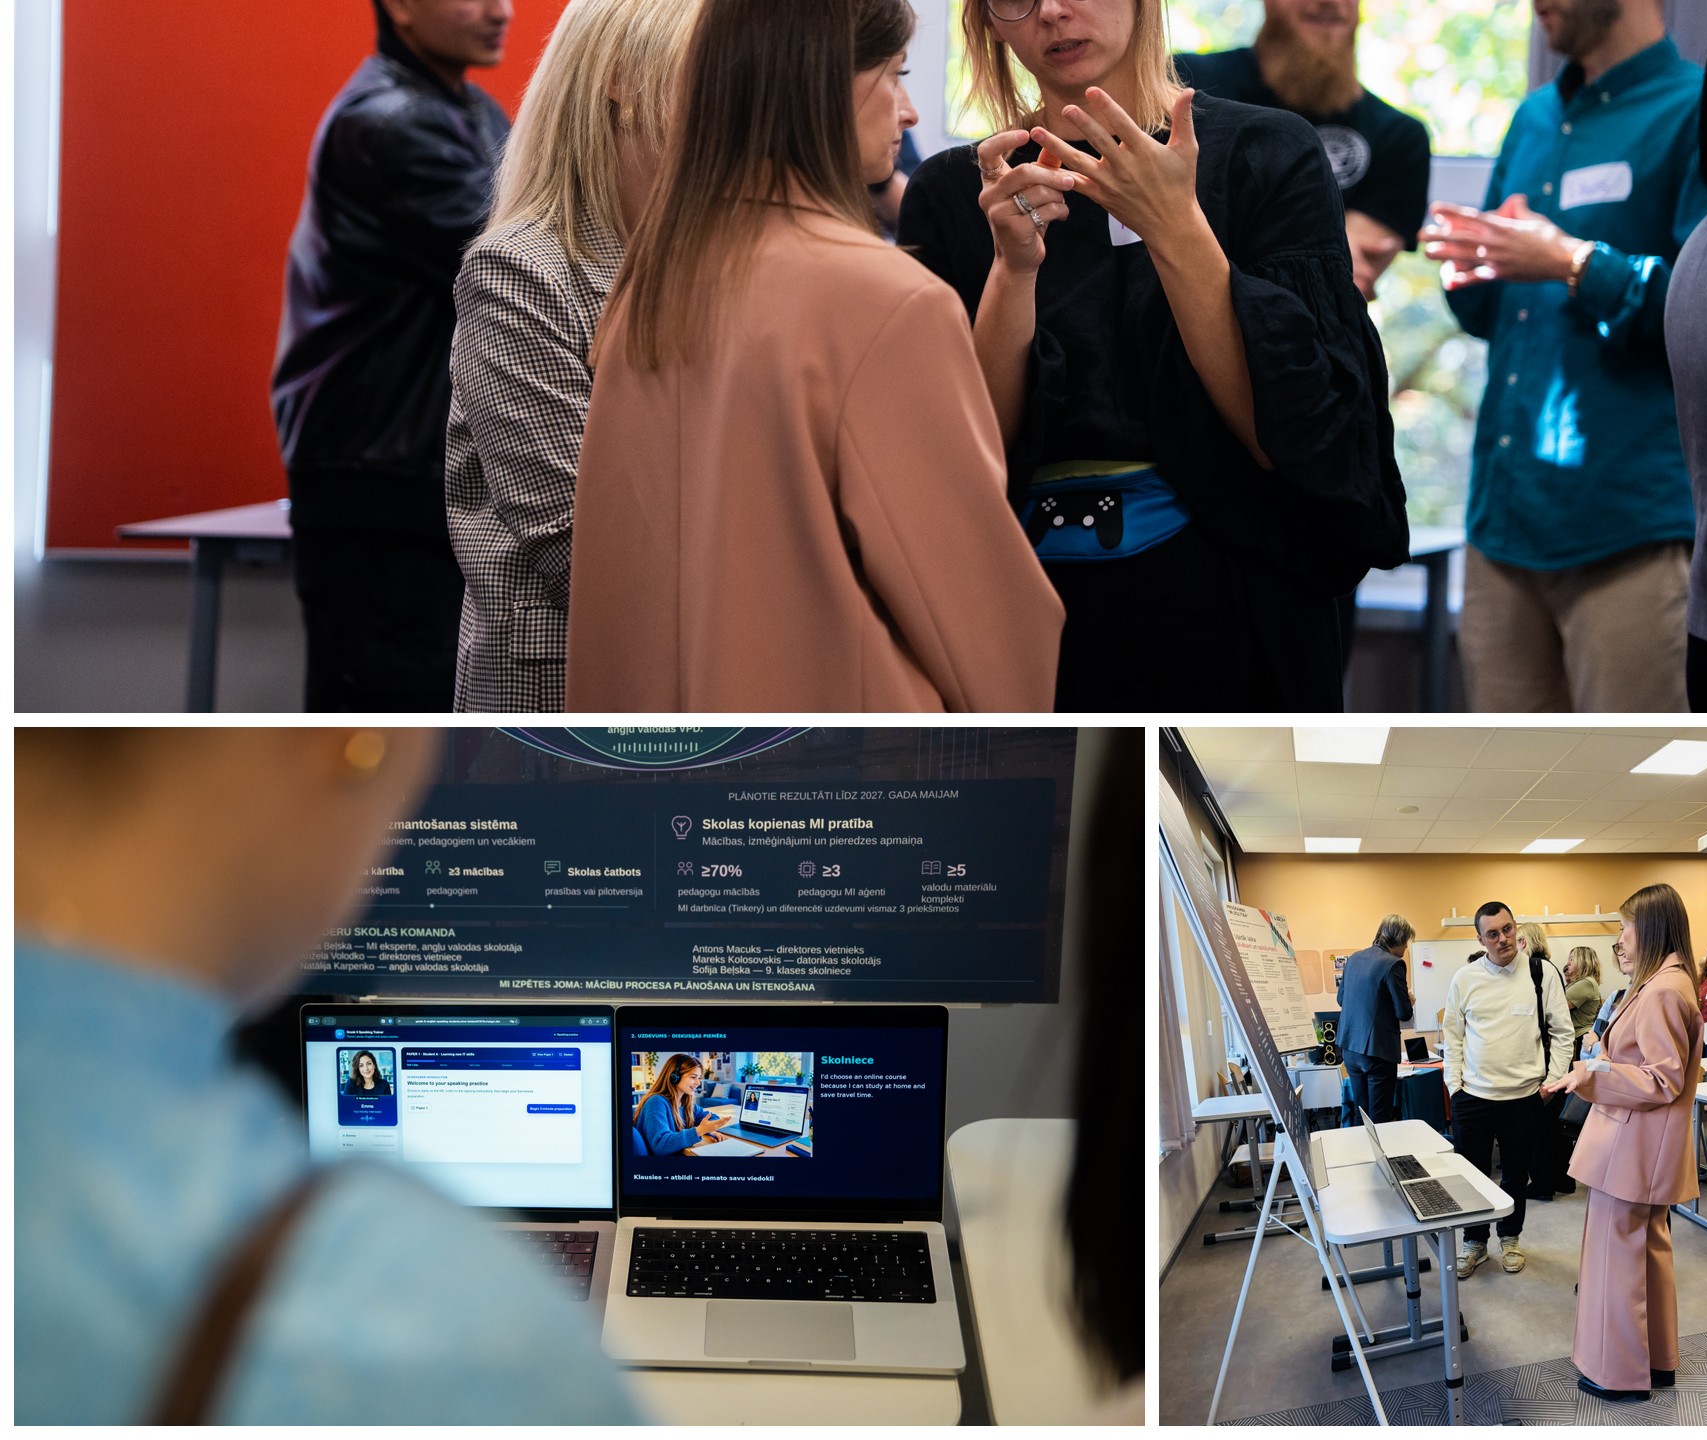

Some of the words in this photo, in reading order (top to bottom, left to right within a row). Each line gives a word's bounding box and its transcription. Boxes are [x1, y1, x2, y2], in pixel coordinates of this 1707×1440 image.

[728, 790, 777, 801] PLĀNOTIE
[779, 790, 833, 801] REZULTĀTI
[836, 790, 858, 800] LĪDZ
[860, 791, 886, 800] 2027.
[888, 790, 915, 800] GADA
[917, 790, 959, 799] MAIJAM
[702, 818, 745, 830] Skolas
[749, 818, 805, 833] kopienas
[810, 818, 824, 829] MI
[828, 817, 873, 833] pratība
[702, 835, 745, 847] Mācības,
[749, 835, 811, 848] izmēģinājumi
[815, 837, 826, 845] un
[829, 835, 877, 848] pieredzes
[880, 835, 923, 847] apmaiņa
[449, 867, 460, 876] ≥3
[463, 866, 504, 877] mācības
[568, 867, 601, 877] Skolas
[604, 866, 641, 877] čatbots
[702, 864, 742, 878] ≥70%
[822, 864, 840, 877] ≥3
[947, 864, 966, 877] ≥5
[678, 887, 719, 897] pedagogu
[721, 887, 760, 896] mācībās
[798, 887, 841, 897] pedagogu
[844, 888, 855, 896] MI
[858, 887, 885, 897] aģenti
[691, 904, 726, 912] darbnīca
[728, 904, 764, 915] (Tinkery)
[779, 904, 822, 913] diferencēti
[825, 904, 864, 913] uzdevumi
[907, 904, 959, 915] priekšmetos
[693, 945, 724, 954] Antons
[727, 945, 761, 954] Macuks
[777, 945, 821, 954] direktores
[824, 946, 864, 954] vietnieks
[693, 955, 725, 964] Mareks
[728, 955, 781, 964] Kolosovskis
[797, 956, 838, 965] datorikas
[841, 956, 881, 966] skolotājs
[693, 966, 717, 975] Sofija
[720, 966, 750, 976] Beļska
[766, 966, 774, 974] 9.
[777, 966, 805, 975] klases
[808, 966, 851, 975] skolniece
[500, 980, 510, 988] MI
[512, 978, 550, 989] IZPĒTES
[553, 980, 582, 989] JOMA:
[586, 979, 622, 989] MĀCĪBU
[625, 981, 671, 990] PROCESA
[674, 980, 733, 991] PLĀNOŠANA
[736, 983, 749, 991] UN
[752, 980, 815, 992] ĪSTENOŠANA
[821, 1055, 874, 1064] Skolniece
